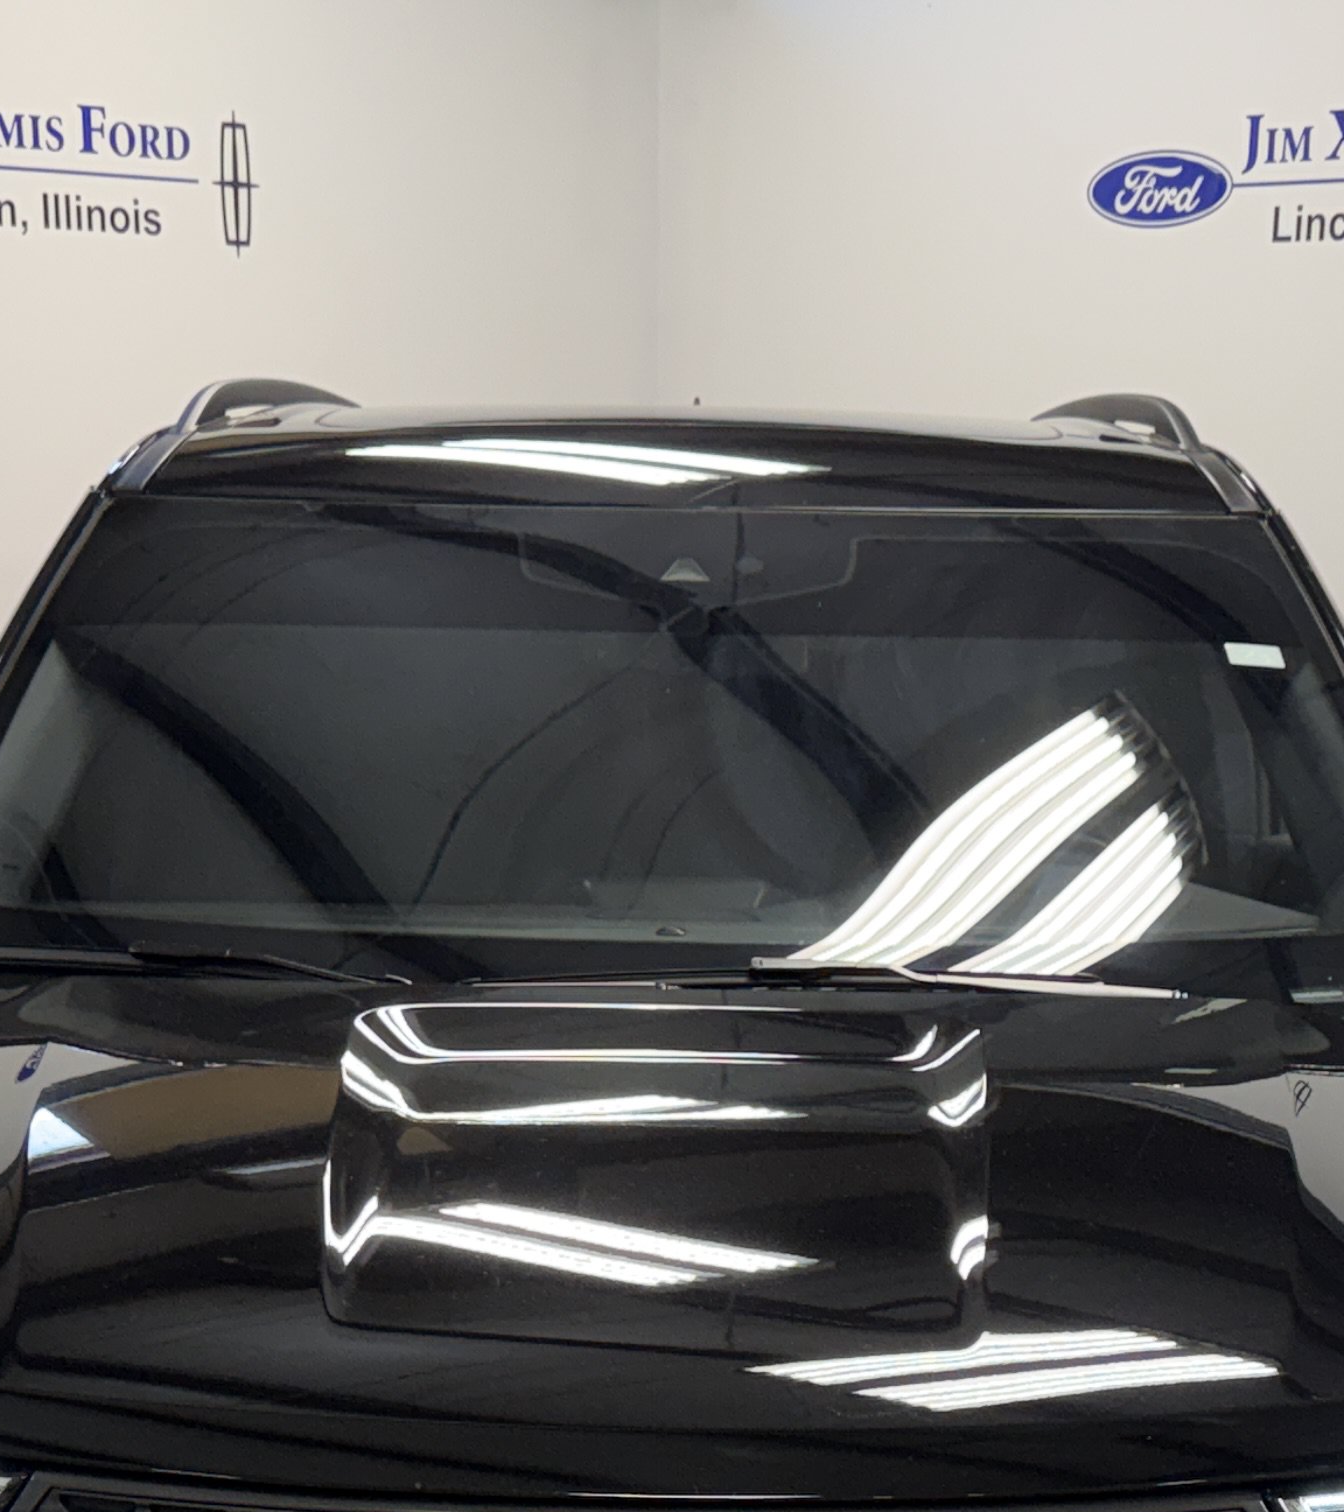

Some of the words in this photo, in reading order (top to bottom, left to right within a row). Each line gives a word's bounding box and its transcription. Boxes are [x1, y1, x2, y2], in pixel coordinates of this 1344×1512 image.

[77, 104, 191, 161] FORD
[1242, 113, 1314, 174] JIM
[42, 193, 162, 235] Illinois
[1113, 164, 1202, 216] Ford
